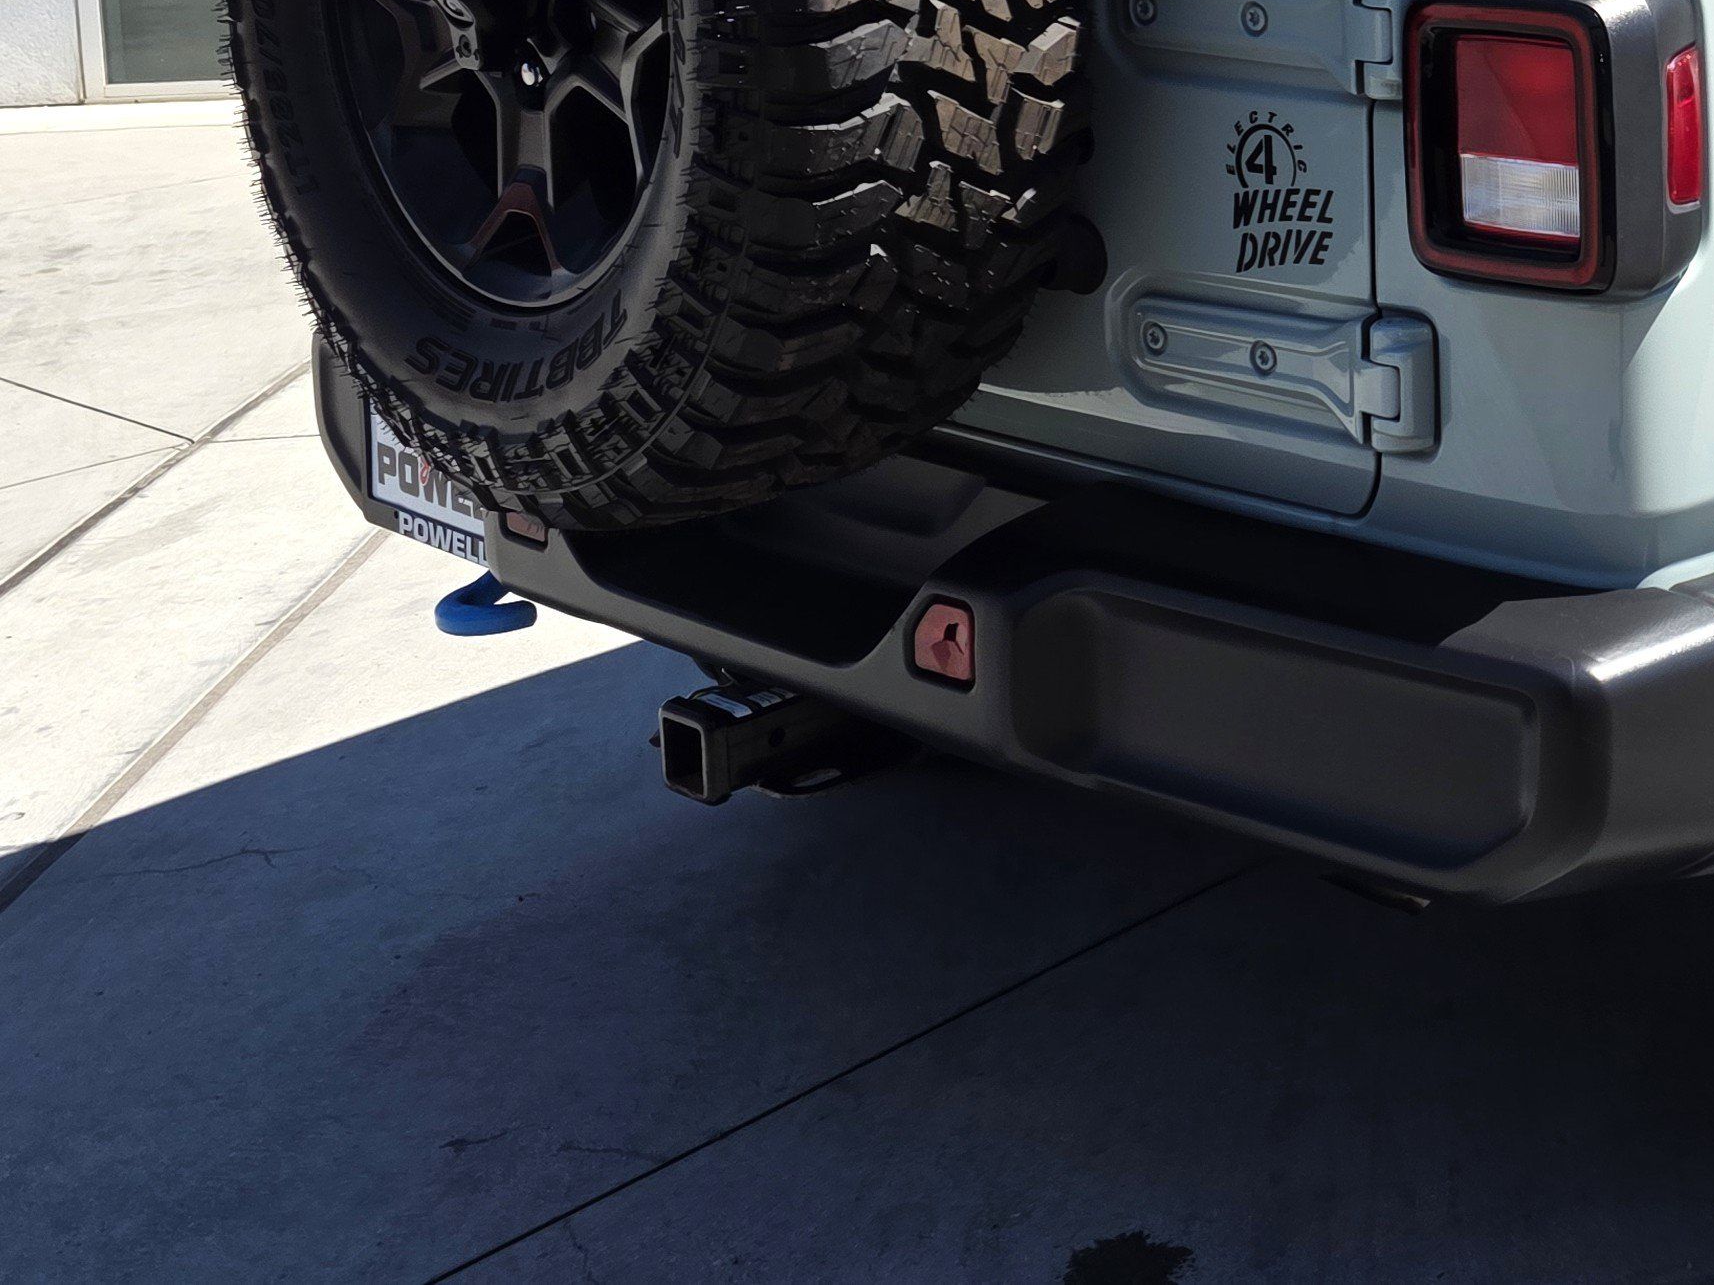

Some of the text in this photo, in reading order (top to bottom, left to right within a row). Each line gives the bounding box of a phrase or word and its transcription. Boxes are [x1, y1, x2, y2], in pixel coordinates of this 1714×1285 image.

[1225, 109, 1308, 176] ELECTRIC
[1245, 134, 1278, 185] 4
[1232, 187, 1335, 230] WHEEL
[1235, 228, 1334, 273] DRIVE
[404, 293, 629, 403] TBBTIRES
[400, 512, 491, 567] POWELL
